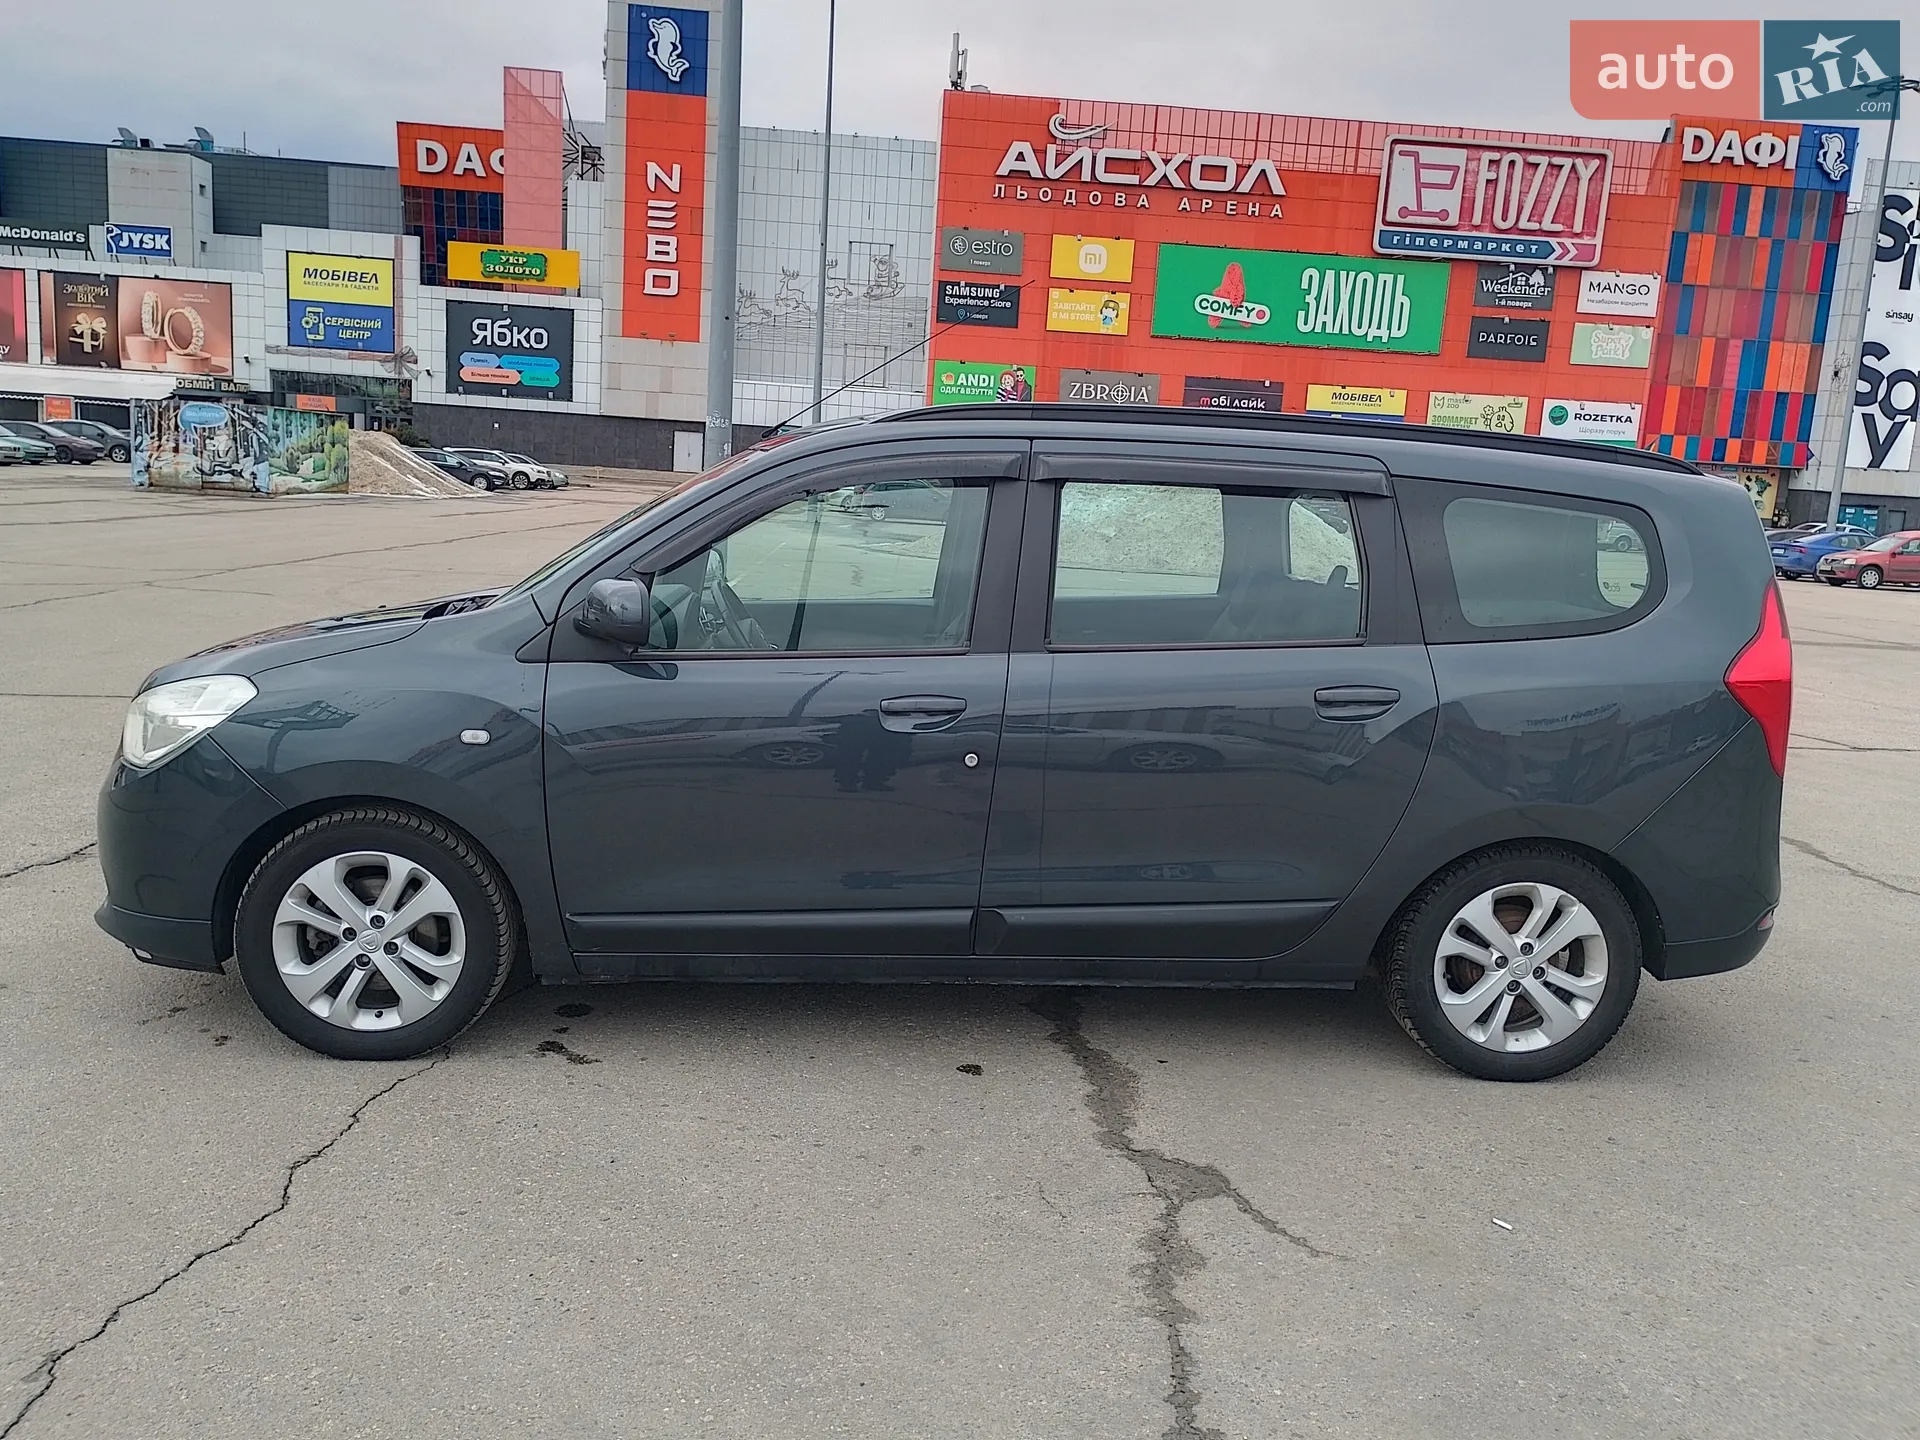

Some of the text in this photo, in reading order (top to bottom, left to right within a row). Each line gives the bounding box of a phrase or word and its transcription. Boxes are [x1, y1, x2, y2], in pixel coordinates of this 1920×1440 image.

[1471, 151, 1601, 235] FOZZY
[992, 183, 1284, 219] ЛЬОДОВА АРЕНА
[0, 225, 87, 243] McDonald's
[642, 160, 682, 297] NEBO
[118, 231, 171, 251] JYSK
[971, 239, 1014, 257] estro
[1391, 233, 1541, 255] гіпермаркет
[499, 255, 528, 265] УКР
[302, 267, 379, 285] МОБІВЕЛ
[485, 263, 541, 276] ЗОЛОТО
[303, 280, 340, 288] АКСЕСУАРИ
[945, 284, 1001, 298] SAMSUNG
[1480, 273, 1552, 297] Weekender
[1588, 280, 1651, 296] MANGO
[944, 296, 1012, 308] Experience Store
[1053, 301, 1097, 312] ЗАВІТАЙТЕ
[1199, 296, 1256, 319] COMFY
[1296, 266, 1412, 343] ЗАХОДЬ
[1506, 300, 1533, 309] поверх
[324, 316, 382, 329] СЕРВІСНИЙ
[1070, 313, 1096, 322] STORE
[1884, 309, 1914, 323] sinsay
[338, 329, 372, 340] ЦЕНТР
[471, 317, 549, 350] Ябко
[1478, 331, 1539, 346] PARFOIS
[175, 379, 215, 391] ОБМІН
[956, 372, 995, 388] ANDI
[940, 385, 993, 396] ОДЯГ&ВЗУТТЯ
[1331, 392, 1382, 403] МОБІВЕЛ
[1200, 395, 1266, 409] мобі лайк
[1431, 414, 1480, 425] ЗООМАРКЕТ
[1573, 412, 1634, 424] ROZETKA
